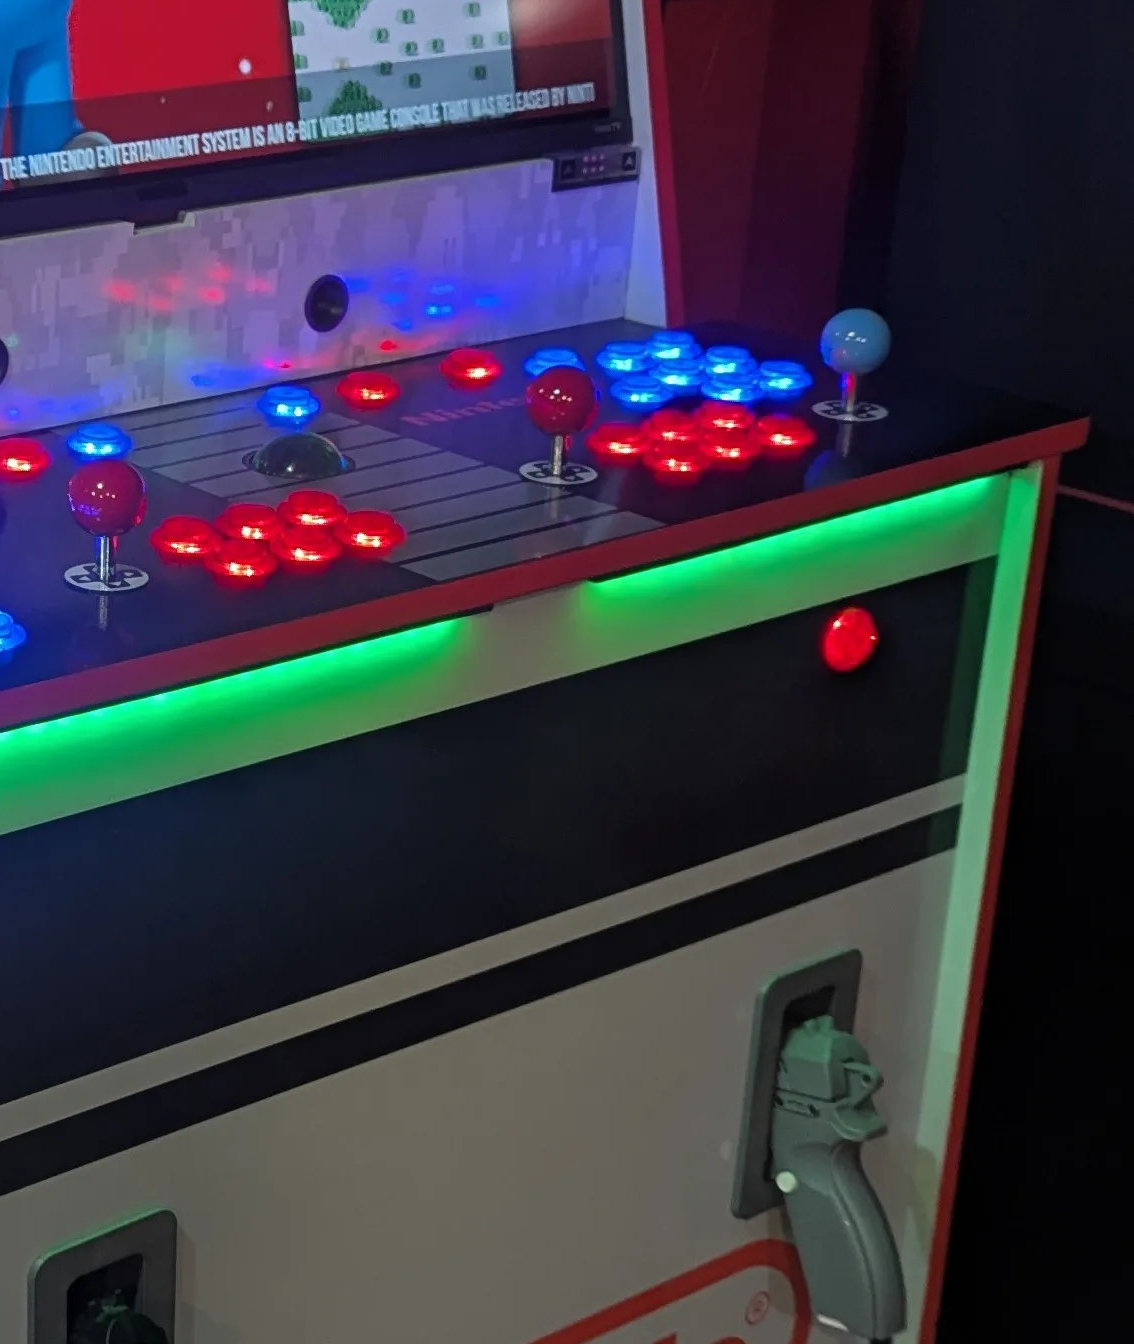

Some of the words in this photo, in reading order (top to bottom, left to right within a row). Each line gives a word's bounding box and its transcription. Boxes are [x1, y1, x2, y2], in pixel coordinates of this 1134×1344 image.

[0, 155, 28, 181] THE
[29, 150, 95, 177] NINTENDO
[97, 135, 201, 167] ENTERTAINMENT
[202, 127, 251, 154] SYSTEM
[252, 125, 265, 147] IS
[267, 122, 285, 145] AN
[285, 117, 317, 142] 8-BIT
[319, 113, 355, 138] VIDEO
[355, 109, 389, 133] GAME
[390, 102, 441, 131] CONSOLE
[441, 99, 468, 125] THAT
[496, 88, 549, 118] RELEASED
[551, 87, 565, 107] BY
